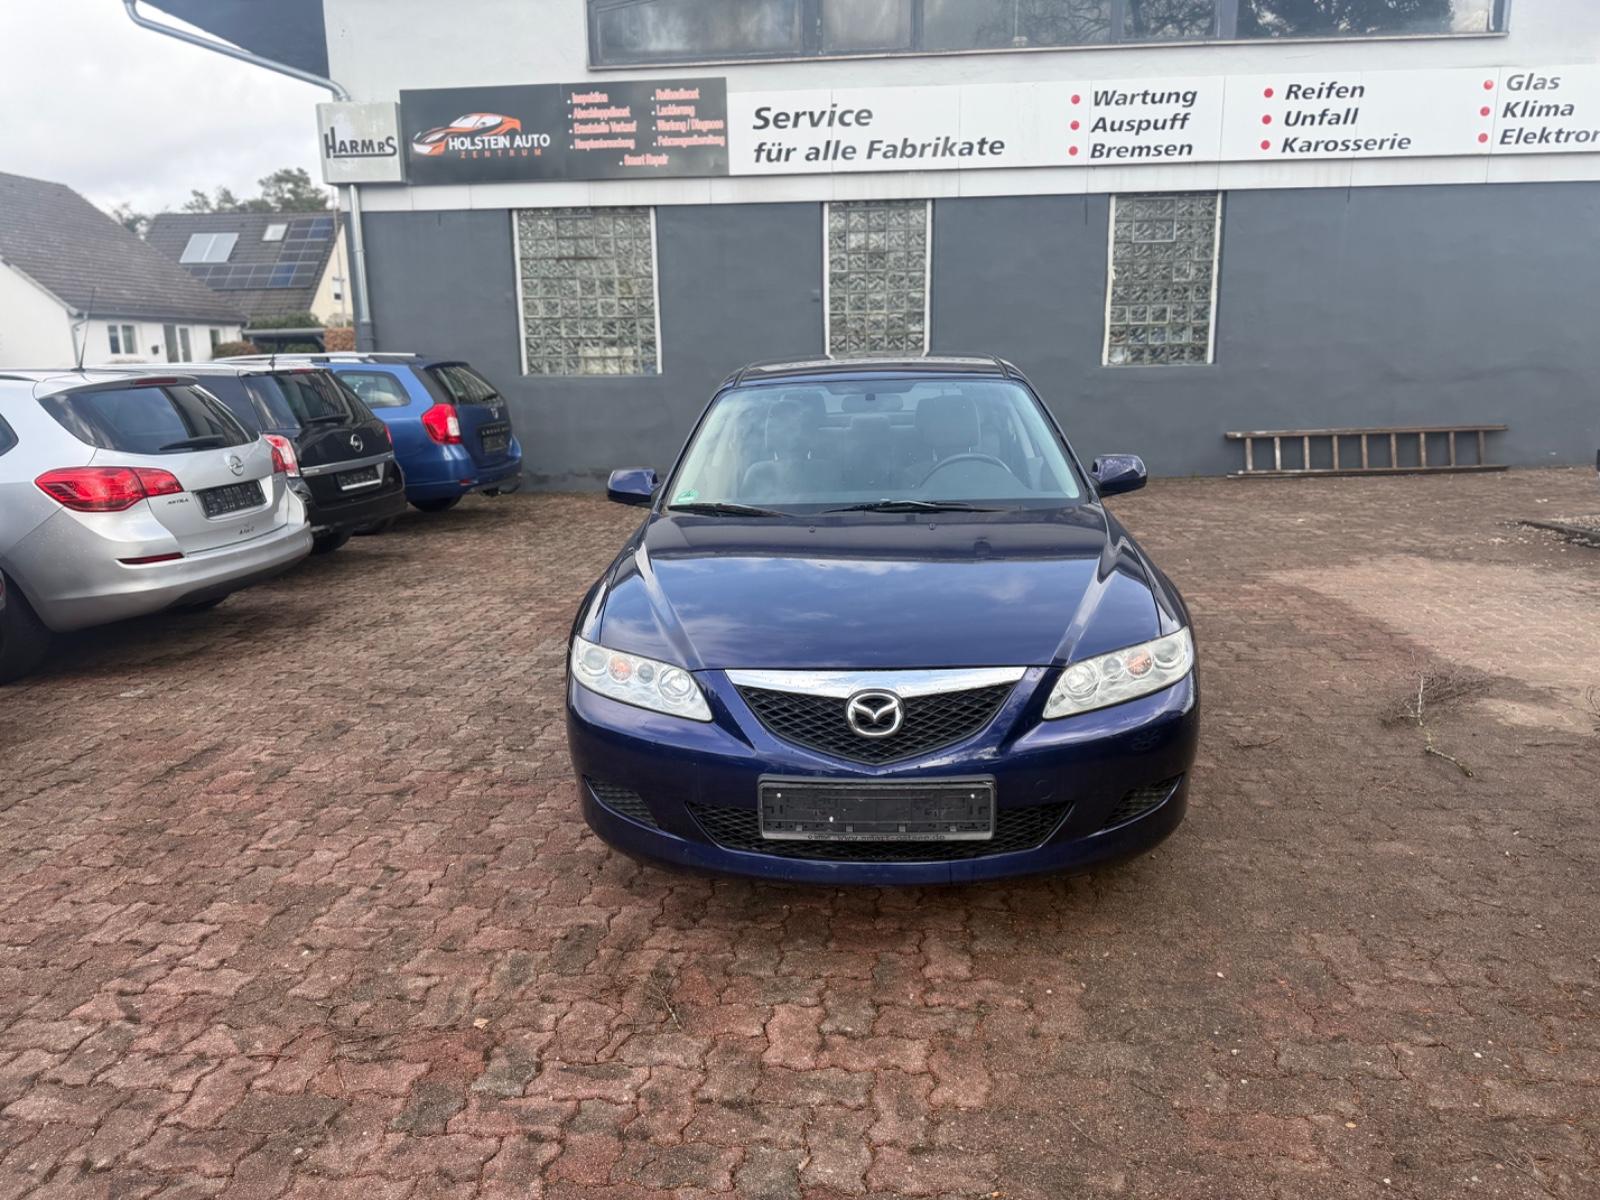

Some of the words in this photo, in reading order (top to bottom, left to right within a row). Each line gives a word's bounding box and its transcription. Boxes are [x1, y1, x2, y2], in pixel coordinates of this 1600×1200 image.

[1284, 81, 1365, 101] Reifen
[1506, 73, 1561, 91] Glas
[1091, 87, 1198, 110] Wartung
[752, 104, 873, 130] Service
[1283, 108, 1359, 127] Unfall
[1502, 100, 1575, 118] Klima
[1090, 112, 1191, 136] Auspuff
[448, 136, 511, 150] HOLSTEIN
[513, 133, 551, 148] AUTO
[753, 141, 797, 163] für
[805, 139, 857, 161] alle
[866, 136, 1006, 160] Fabrikate
[1089, 141, 1193, 160] Bremsen
[1281, 132, 1412, 153] Karosserie
[460, 148, 542, 159] ZENTRUM
